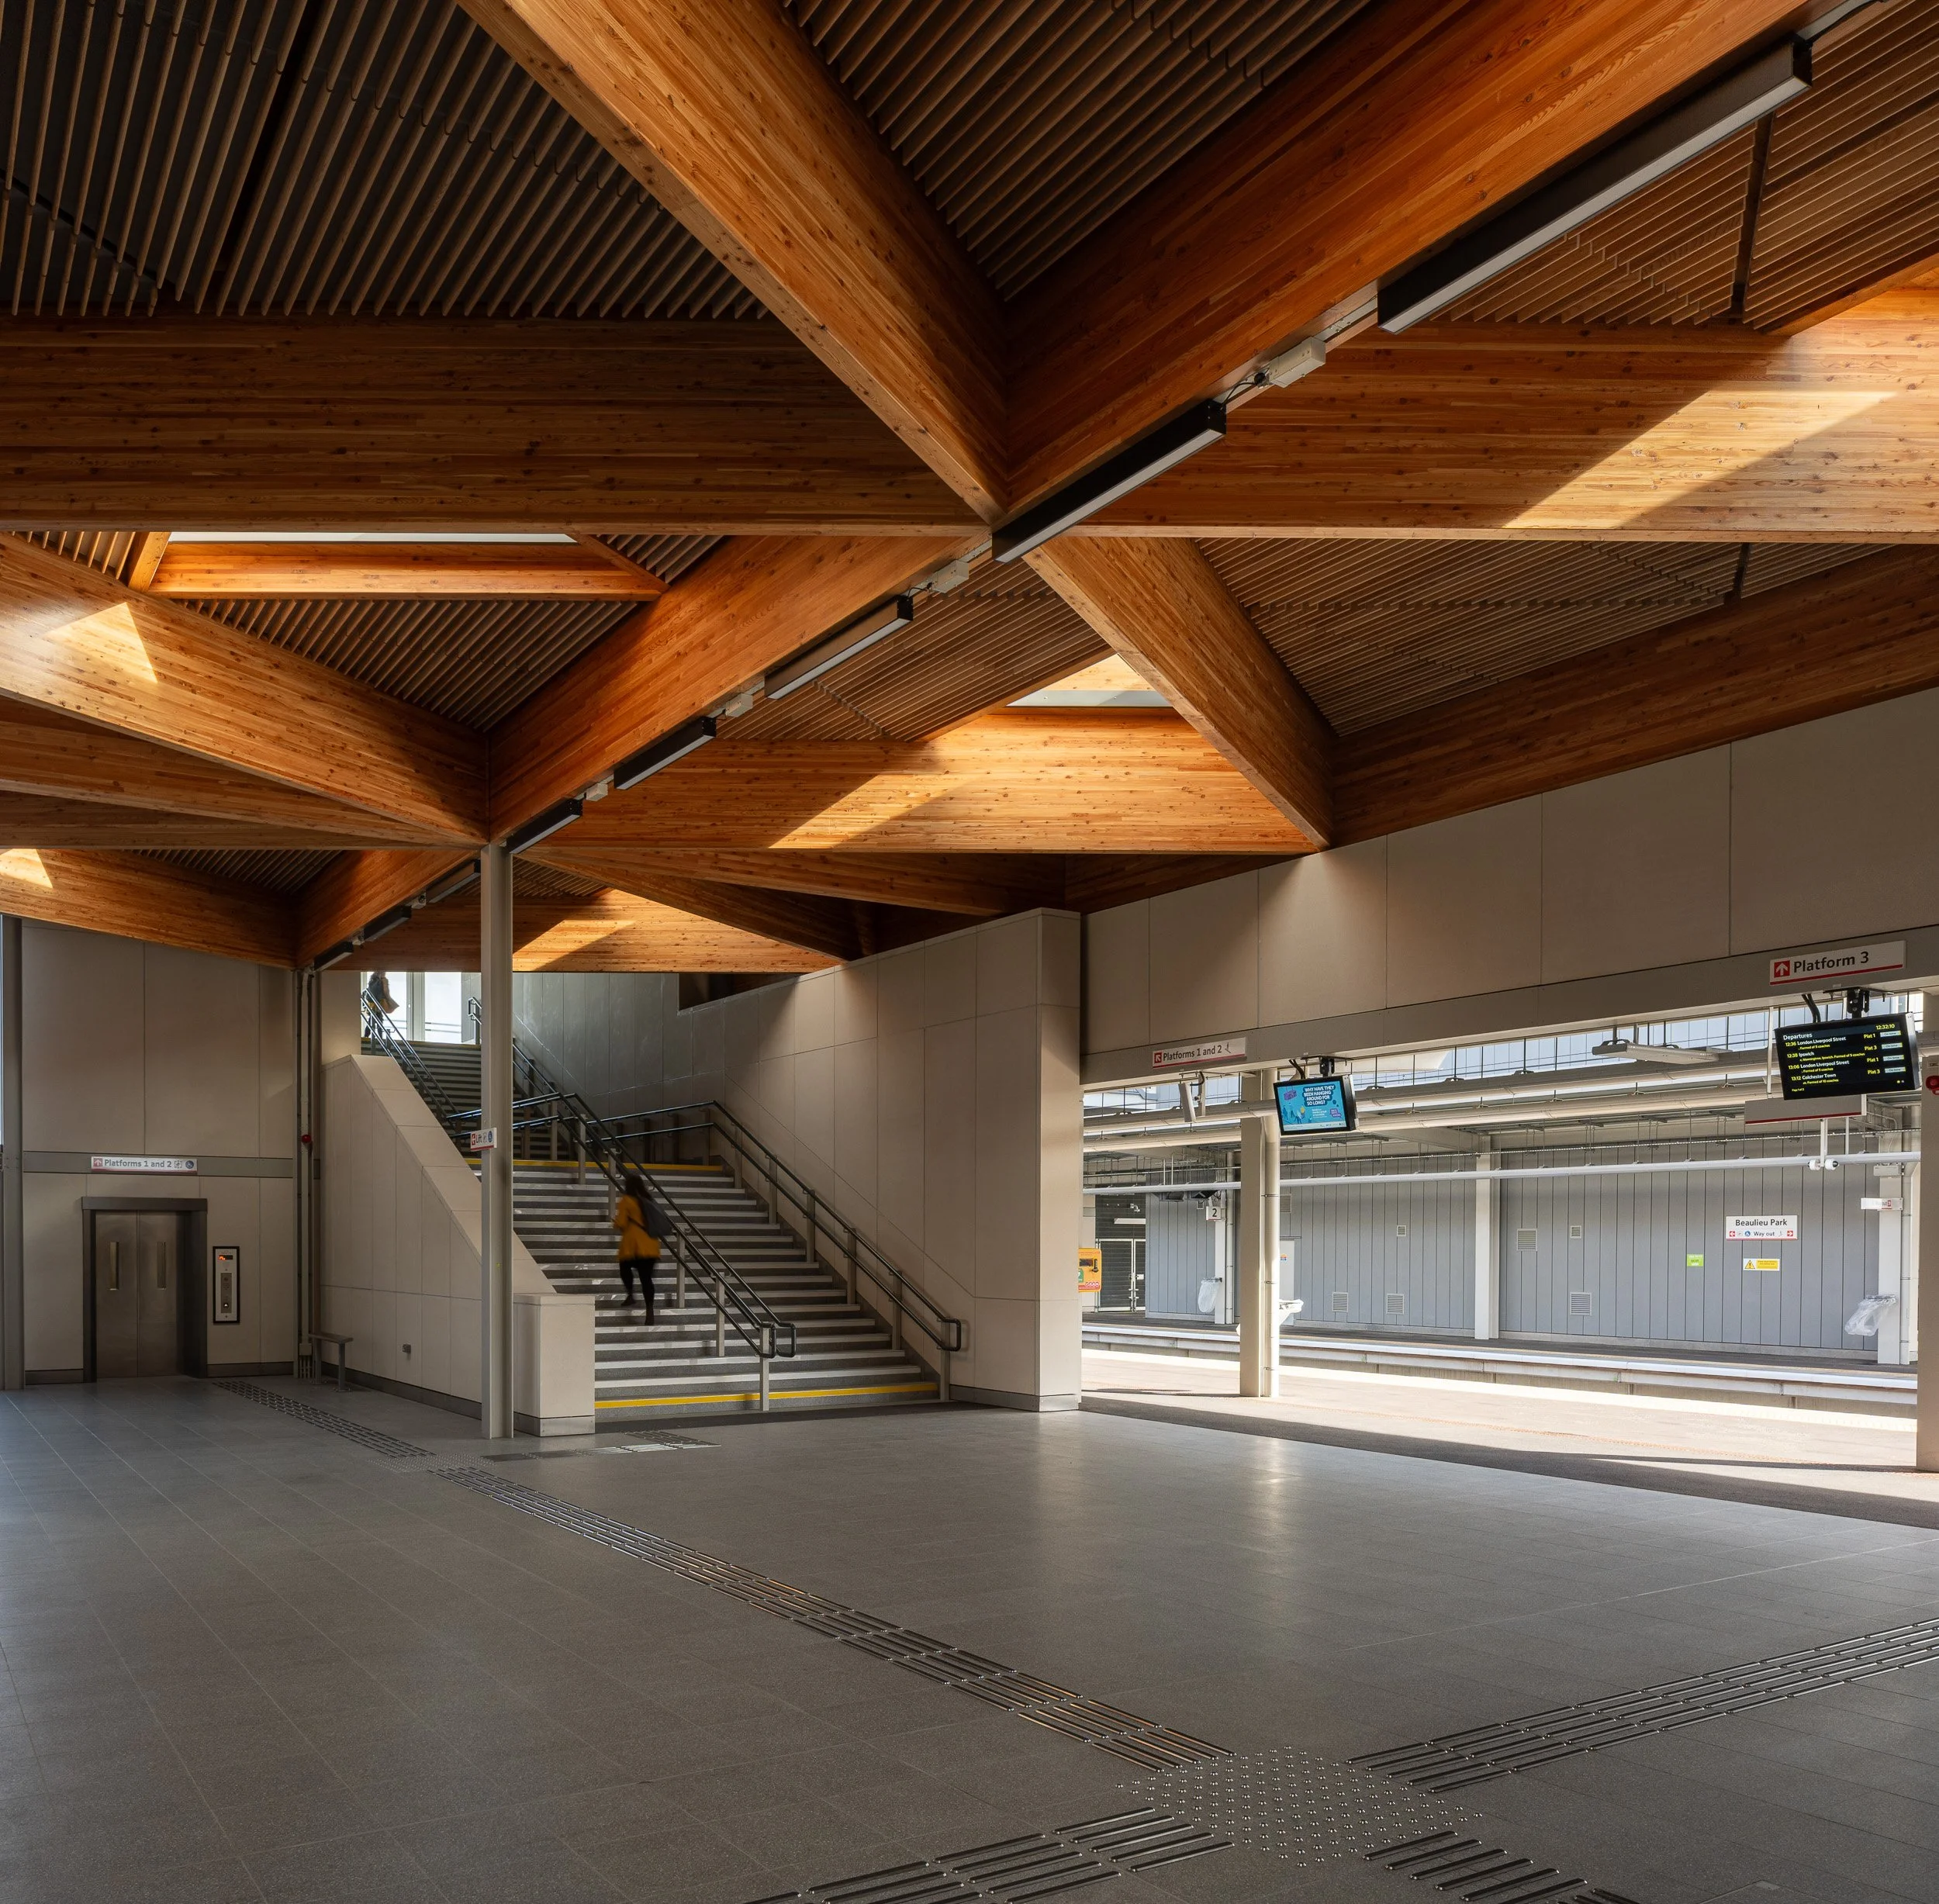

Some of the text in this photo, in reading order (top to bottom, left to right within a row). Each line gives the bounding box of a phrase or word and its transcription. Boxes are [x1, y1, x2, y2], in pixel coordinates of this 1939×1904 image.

[1794, 951, 1869, 973] Platform 3
[1164, 1050, 1195, 1061] Platforms
[1203, 1045, 1215, 1055] and
[1217, 1045, 1222, 1054] 2
[1212, 1208, 1217, 1217] 2
